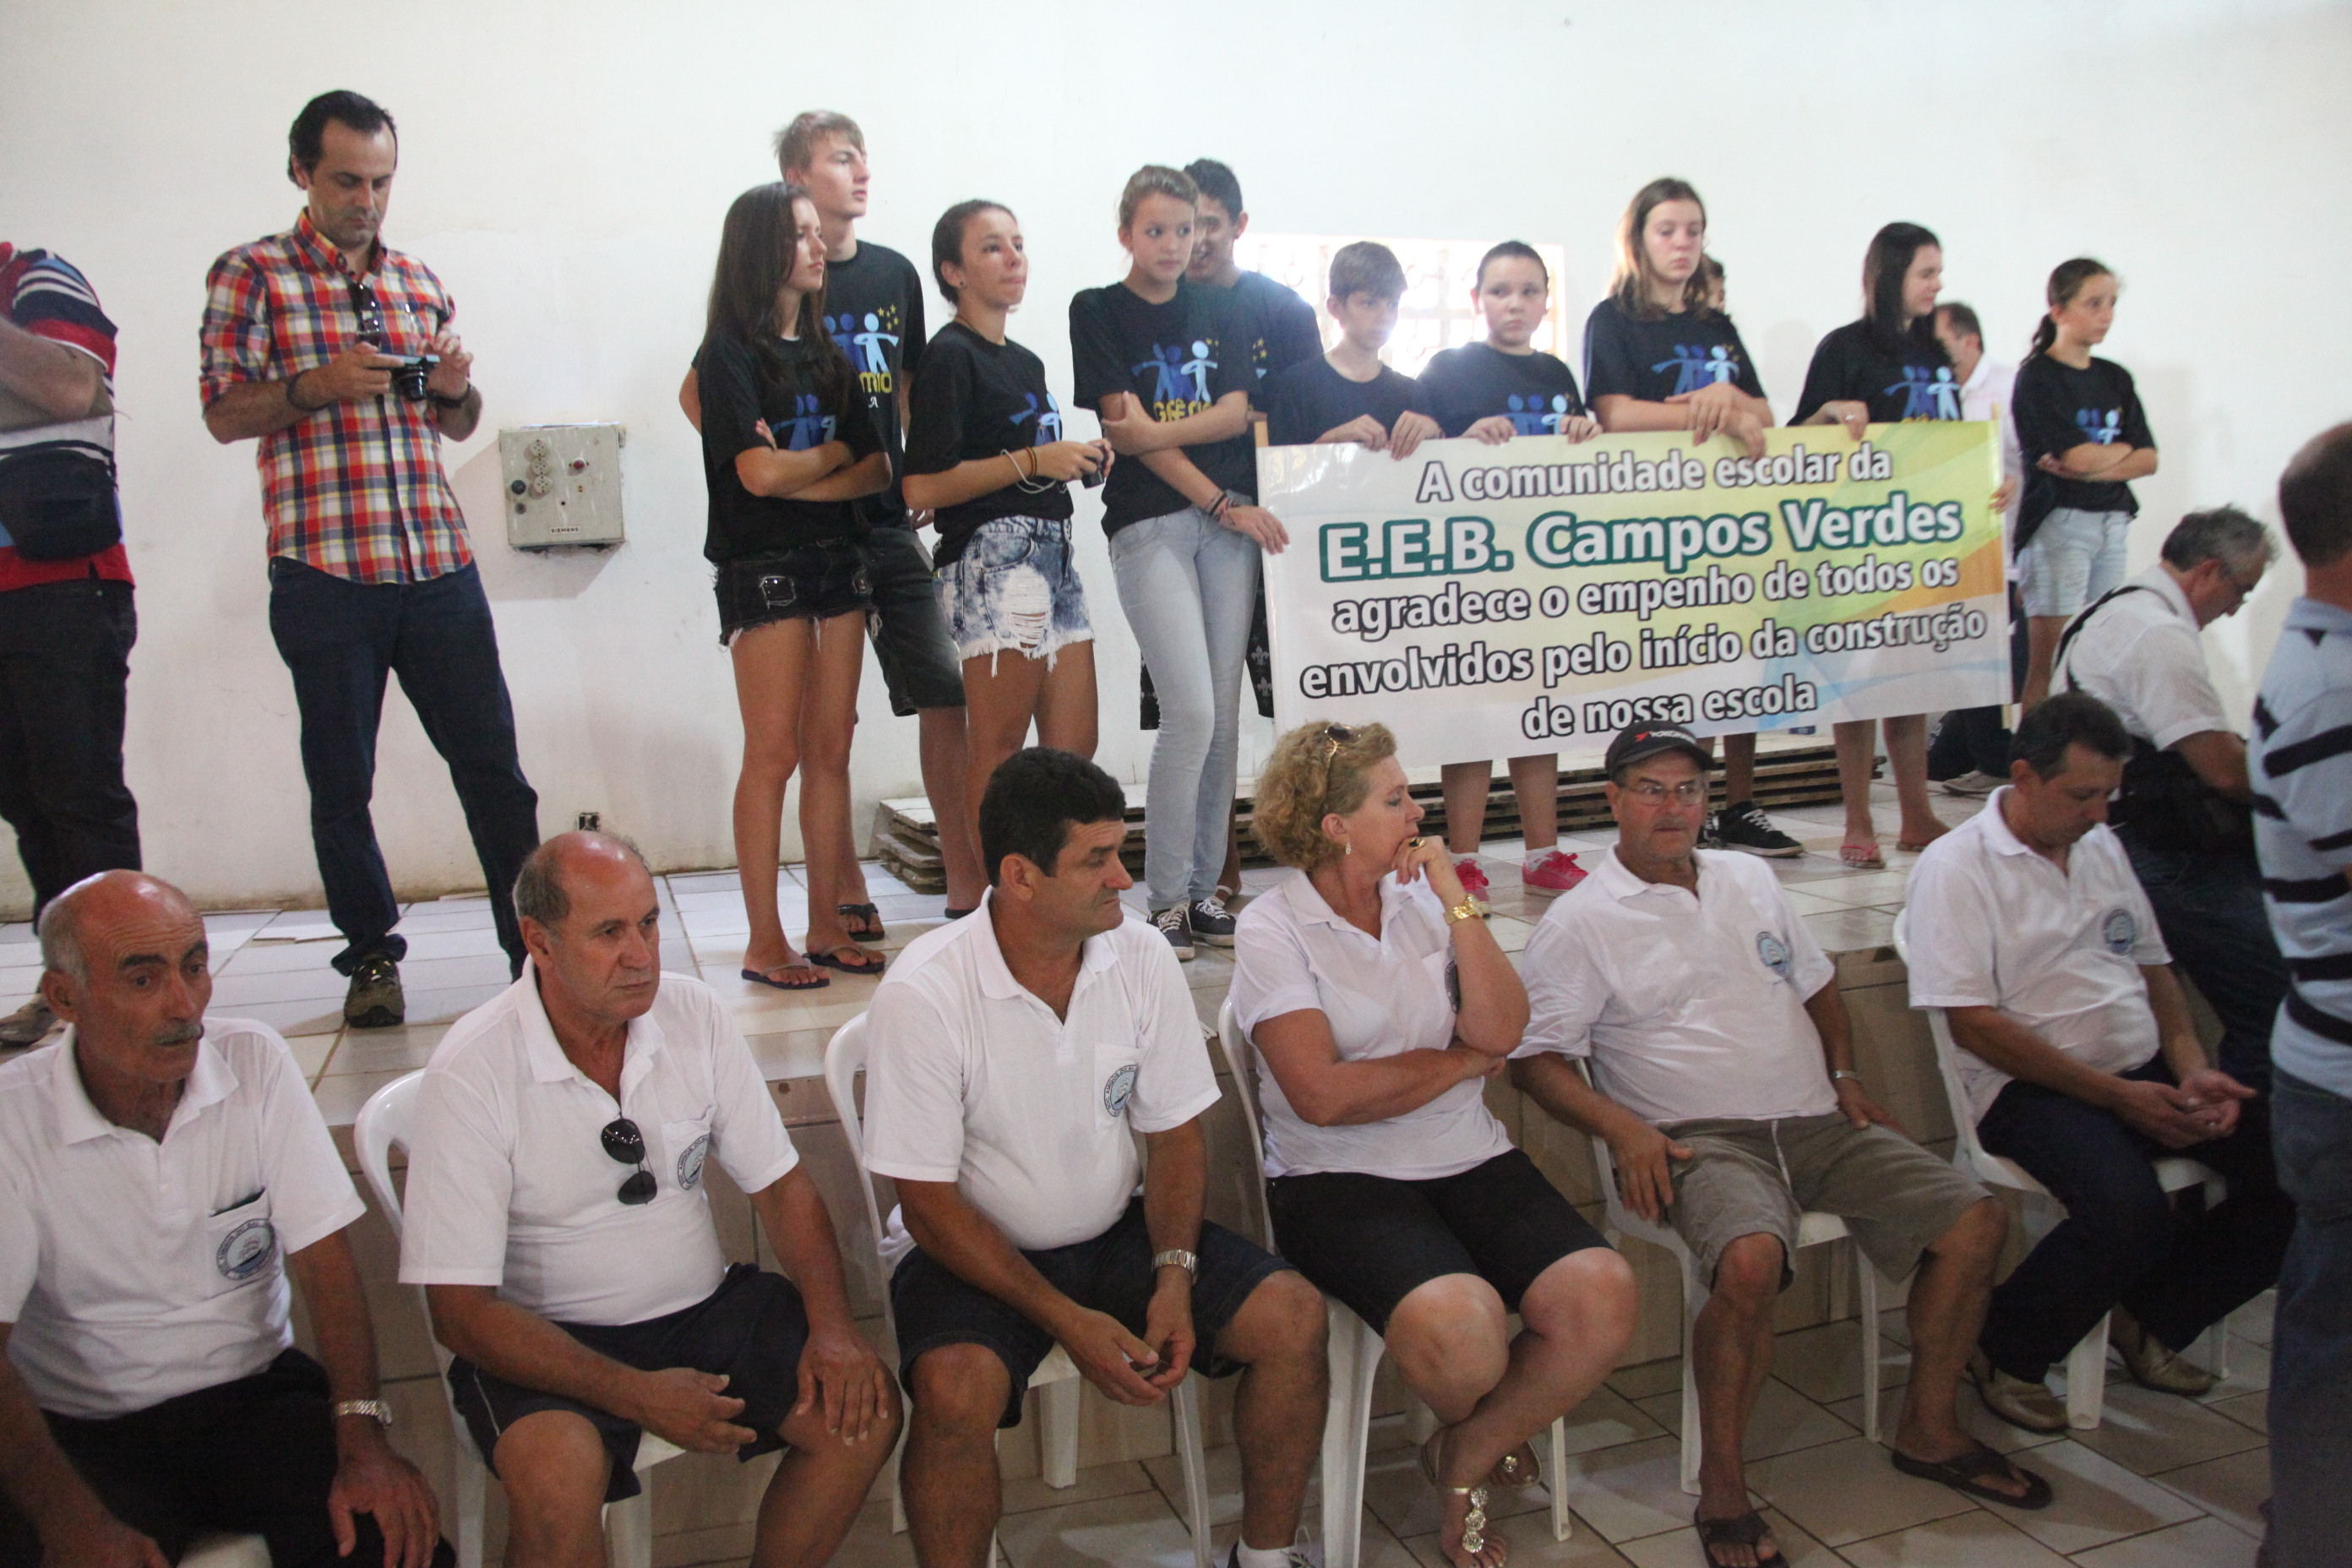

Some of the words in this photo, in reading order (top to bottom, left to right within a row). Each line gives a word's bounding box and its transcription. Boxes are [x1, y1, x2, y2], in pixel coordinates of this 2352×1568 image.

[1416, 460, 1454, 503] A
[1461, 449, 1705, 500] comunidade
[1715, 444, 1841, 488] escolar
[1849, 440, 1892, 482] da
[1319, 515, 1514, 583] E.E.B.
[1526, 510, 1772, 574] Campos
[1780, 490, 1963, 552] Verdes
[1331, 581, 1531, 642] agradece
[1539, 585, 1569, 618] o
[1577, 564, 1755, 621] empenho
[1763, 559, 1810, 601] de
[1816, 553, 1912, 596] todos
[1920, 557, 1959, 588] os
[1299, 641, 1534, 699] envolvidos
[1543, 632, 1631, 689] pelo
[1640, 623, 1742, 669] início
[1751, 618, 1798, 659] da
[1805, 602, 1988, 652] construção
[1522, 695, 1575, 739] de
[1583, 694, 1694, 733] nossa
[1701, 673, 1817, 720] escola
